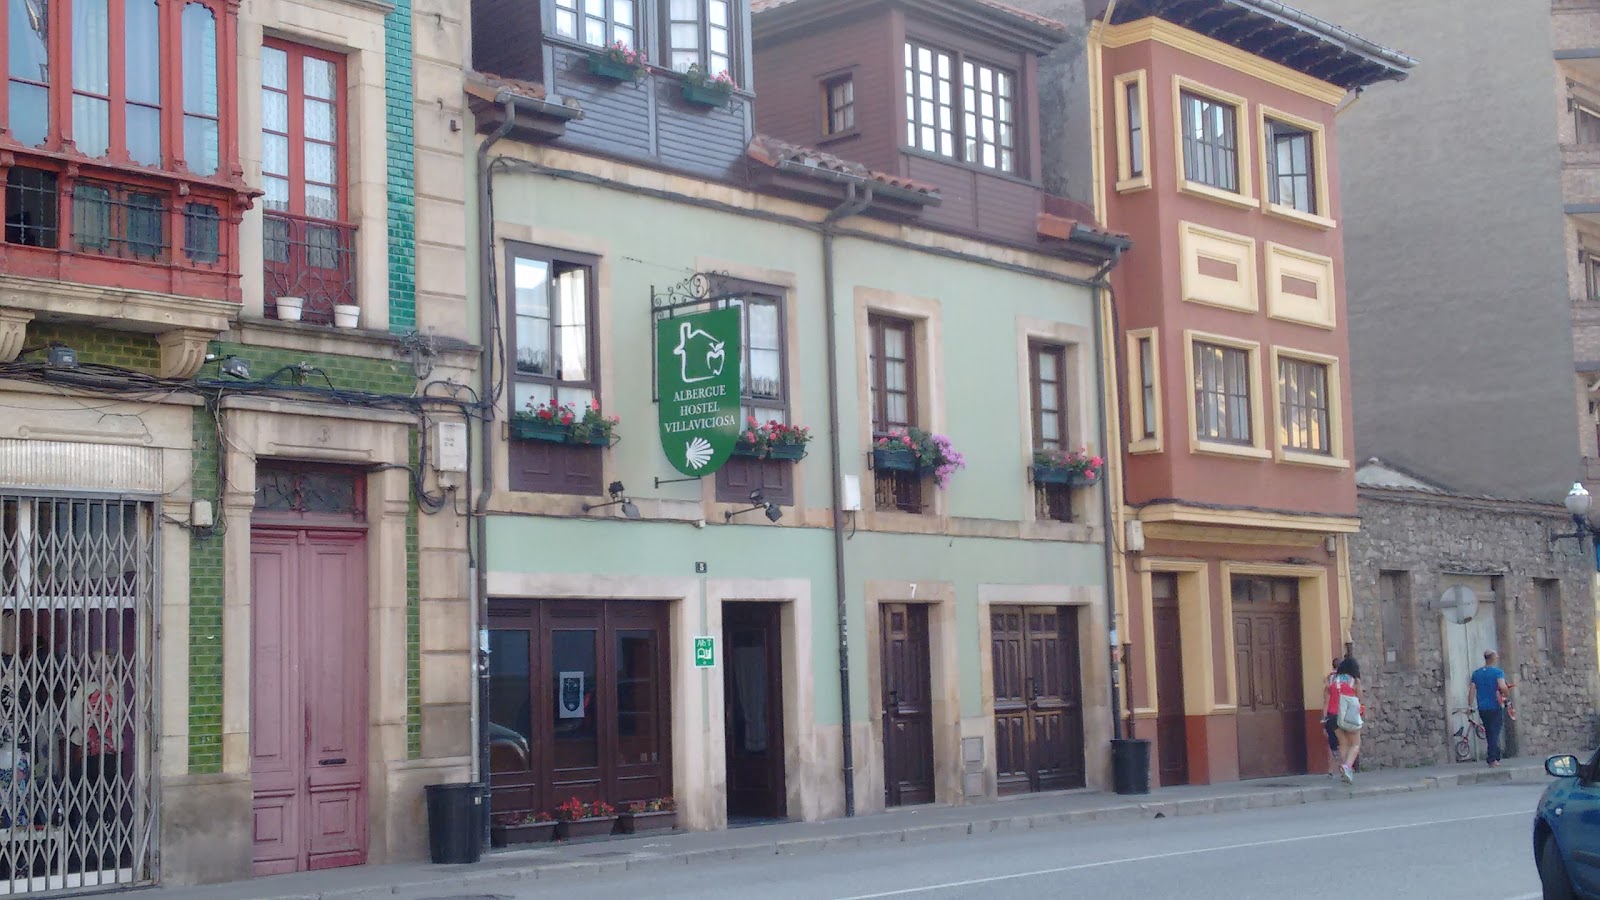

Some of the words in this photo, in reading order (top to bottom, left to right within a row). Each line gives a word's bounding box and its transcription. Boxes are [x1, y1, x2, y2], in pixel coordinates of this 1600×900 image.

[673, 385, 726, 402] ALBERGUE
[680, 401, 720, 417] HOSTEL
[664, 415, 736, 433] VILLAVICIOSA
[909, 583, 917, 599] 7
